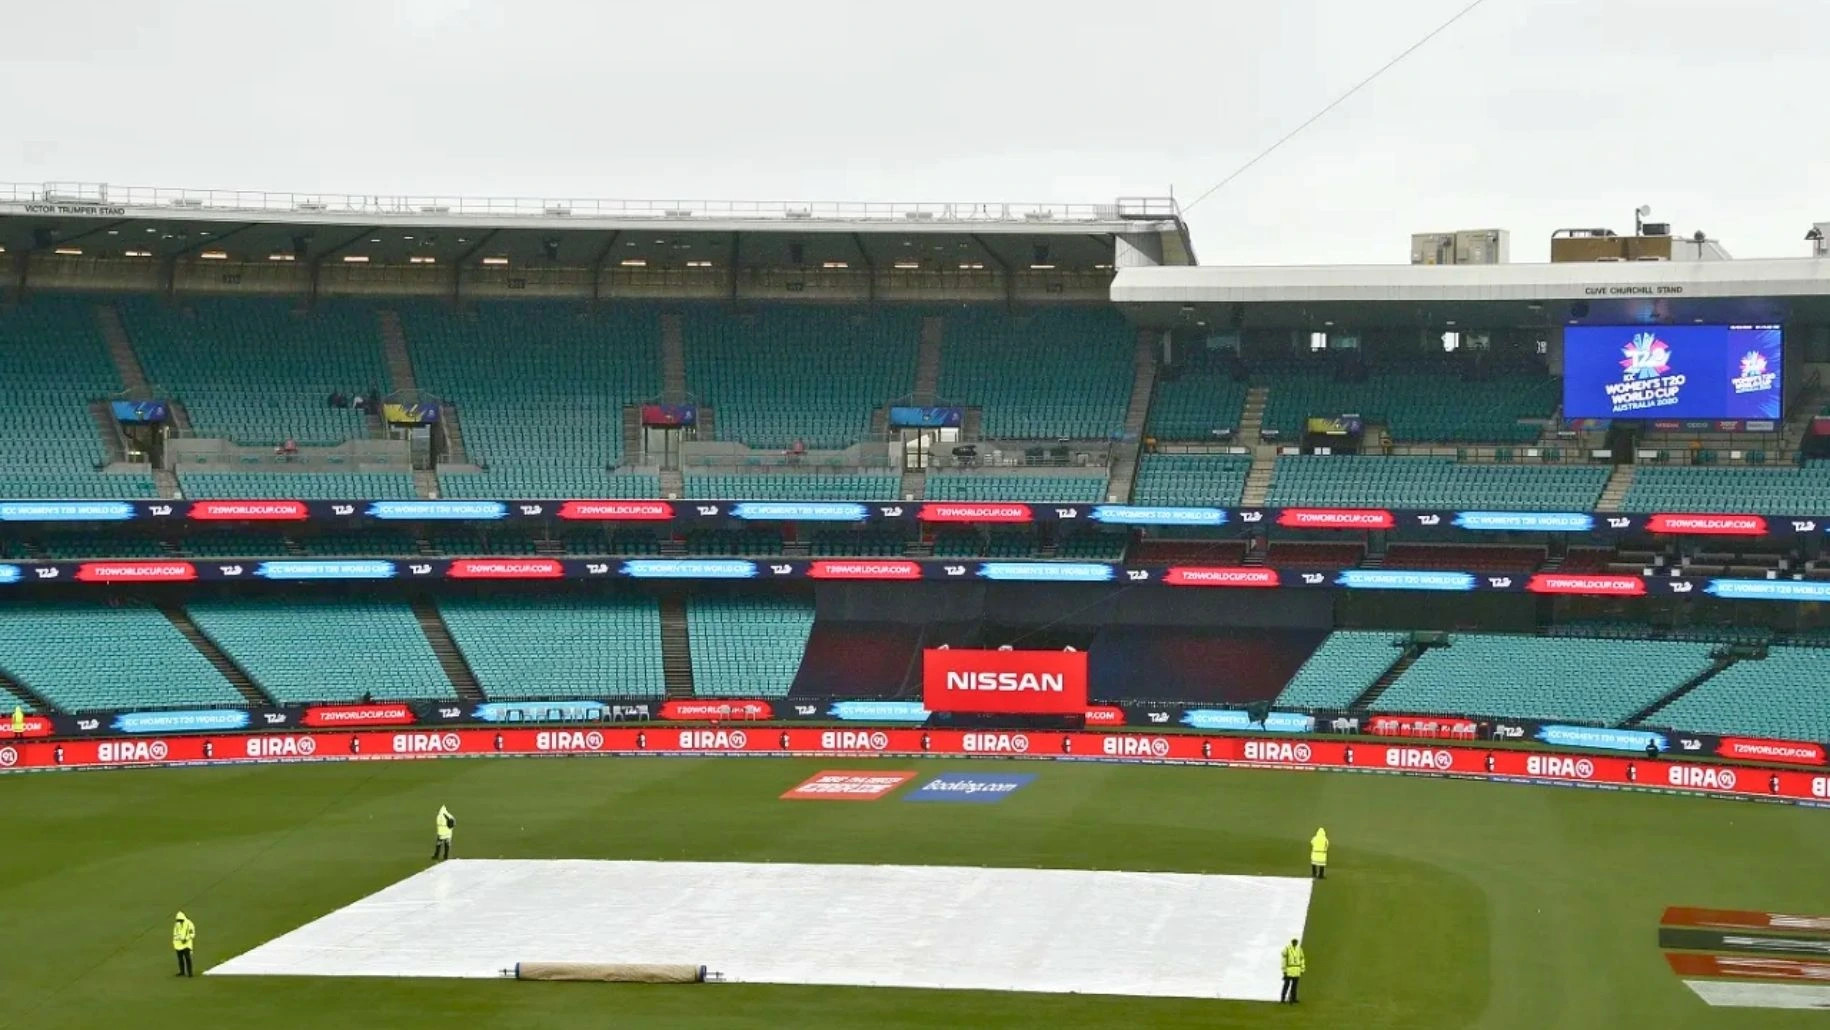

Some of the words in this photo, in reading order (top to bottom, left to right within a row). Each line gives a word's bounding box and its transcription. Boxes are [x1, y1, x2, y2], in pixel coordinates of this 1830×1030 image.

[25, 205, 55, 213] VICTOR
[57, 206, 97, 215] TRUMPER
[100, 207, 125, 215] STAND
[1585, 286, 1606, 295] CLIVE
[1609, 286, 1653, 295] CHURCHILL
[1656, 286, 1683, 294] STAND
[1605, 379, 1661, 395] WOMEN'S
[1661, 374, 1686, 388] T20
[1611, 389, 1654, 404] WORLD
[1654, 386, 1679, 399] CUP
[1612, 400, 1656, 413] AUSTRALIA
[207, 505, 297, 515] T20WORLDCUP.COM
[576, 506, 664, 515] T20WORLDCUP.COM
[936, 507, 1022, 517] T20WORLDCUP.COM
[1296, 513, 1383, 524] T20WORLDCUP.COM
[1666, 518, 1756, 529] T20WORLDCUP.COM
[95, 566, 184, 576] T20WORLDCUP.COM
[466, 564, 552, 574] T20WORLDCUP.COM
[825, 565, 912, 574] T20WORLDCUP.COM
[1182, 571, 1269, 581] T20WORLDCUP.COM
[1545, 579, 1635, 589] T20WORLDCUP.COM
[947, 671, 1063, 691] NISSAN
[321, 710, 405, 721] T20WORLDCUP.COM
[247, 737, 298, 756] BIRA
[393, 734, 442, 752] BIRA
[536, 731, 585, 750] BIRA
[680, 731, 730, 749] BIRA
[821, 731, 871, 750] BIRA
[963, 733, 1010, 752] BIRA
[1103, 737, 1151, 755] BIRA
[98, 742, 149, 761] BIRA
[1244, 742, 1295, 761] BIRA
[1733, 743, 1816, 758] T20WORLDCUP.COM
[1386, 749, 1436, 769] BIRA
[1527, 756, 1576, 777] BIRA
[1668, 765, 1718, 787] BIRA
[921, 779, 1018, 794] Booking.com
